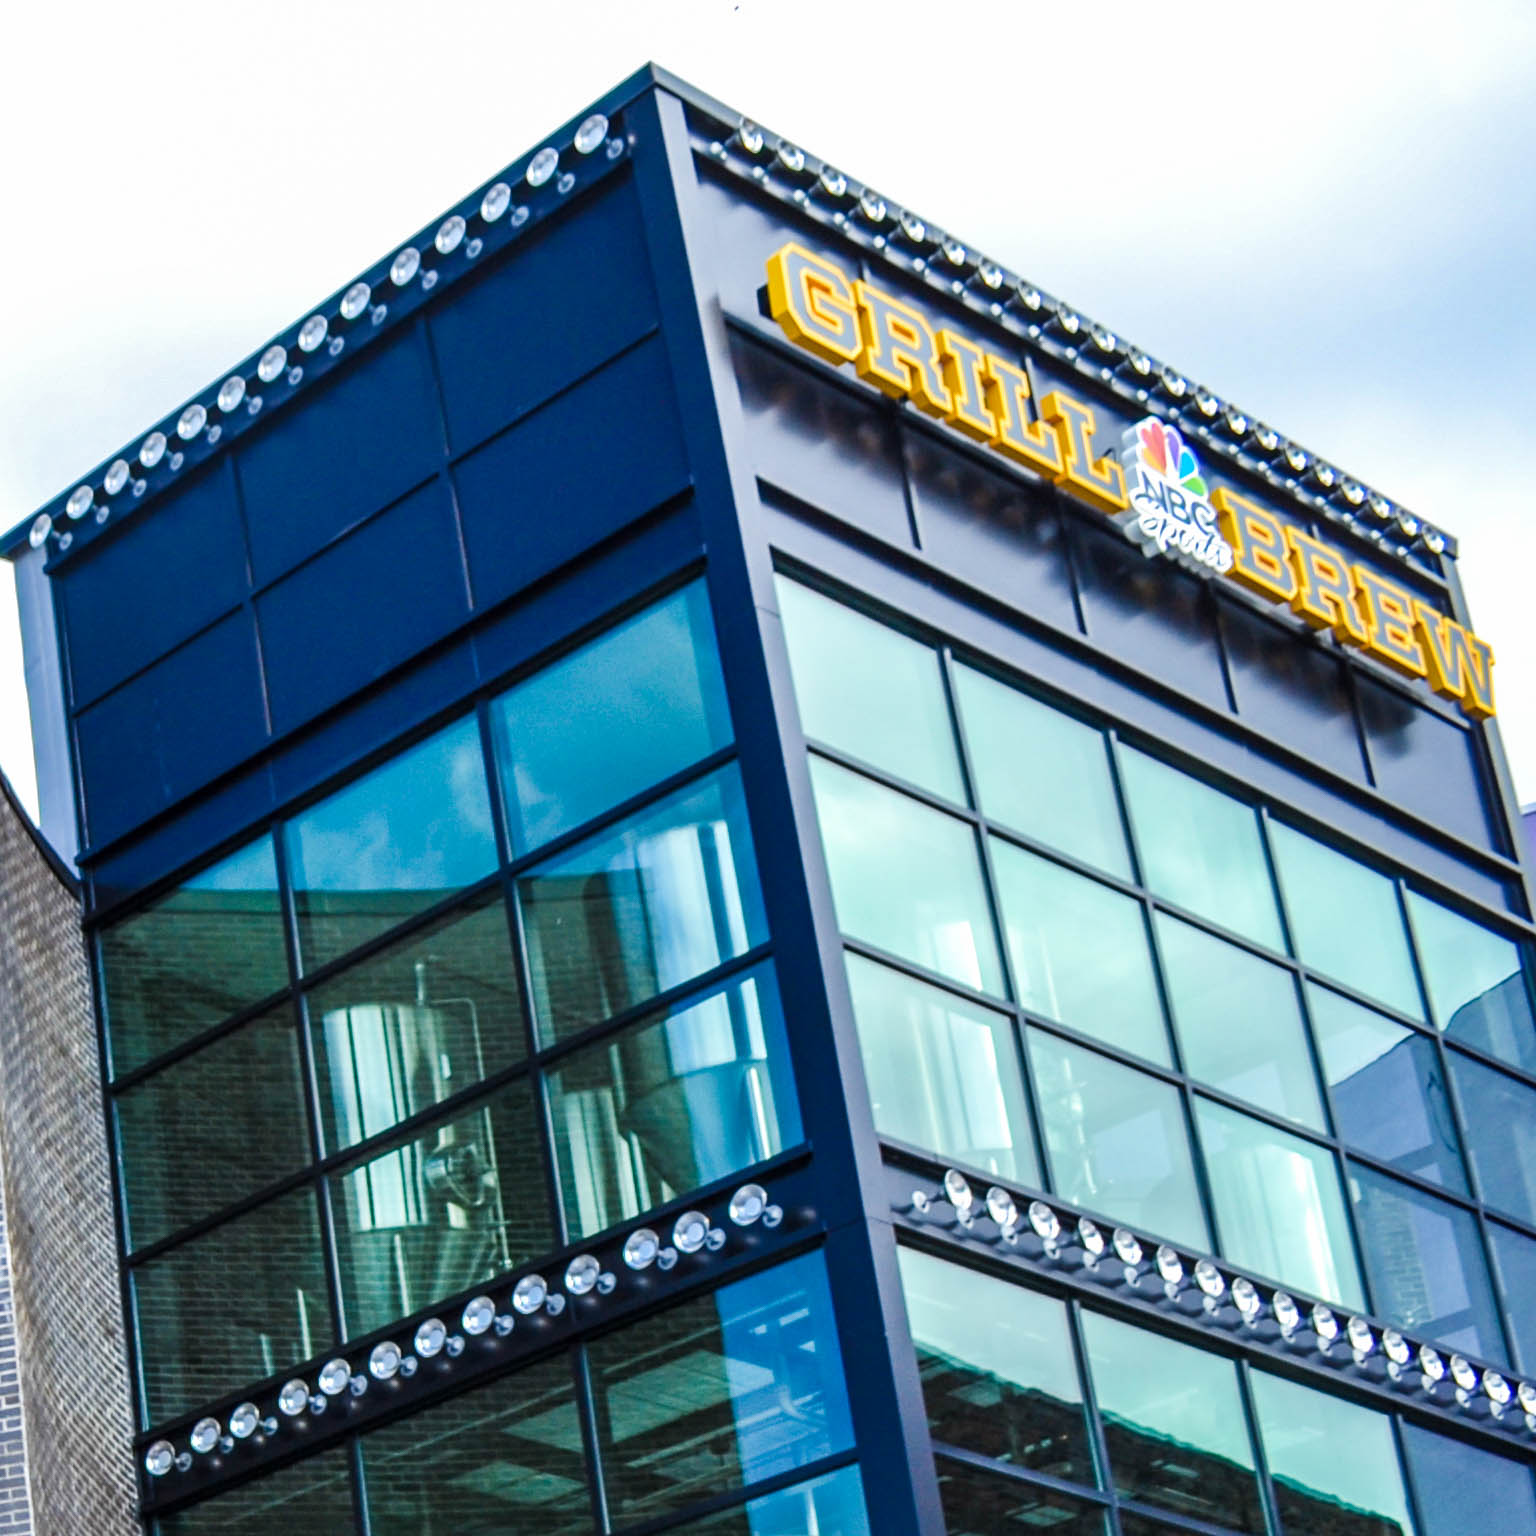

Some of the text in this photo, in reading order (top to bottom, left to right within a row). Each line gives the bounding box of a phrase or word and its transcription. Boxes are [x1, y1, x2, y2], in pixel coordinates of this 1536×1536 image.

[765, 242, 1128, 515] GRILL
[1134, 491, 1230, 566] Sports
[1141, 470, 1216, 536] NBC
[1211, 487, 1496, 722] BREW
